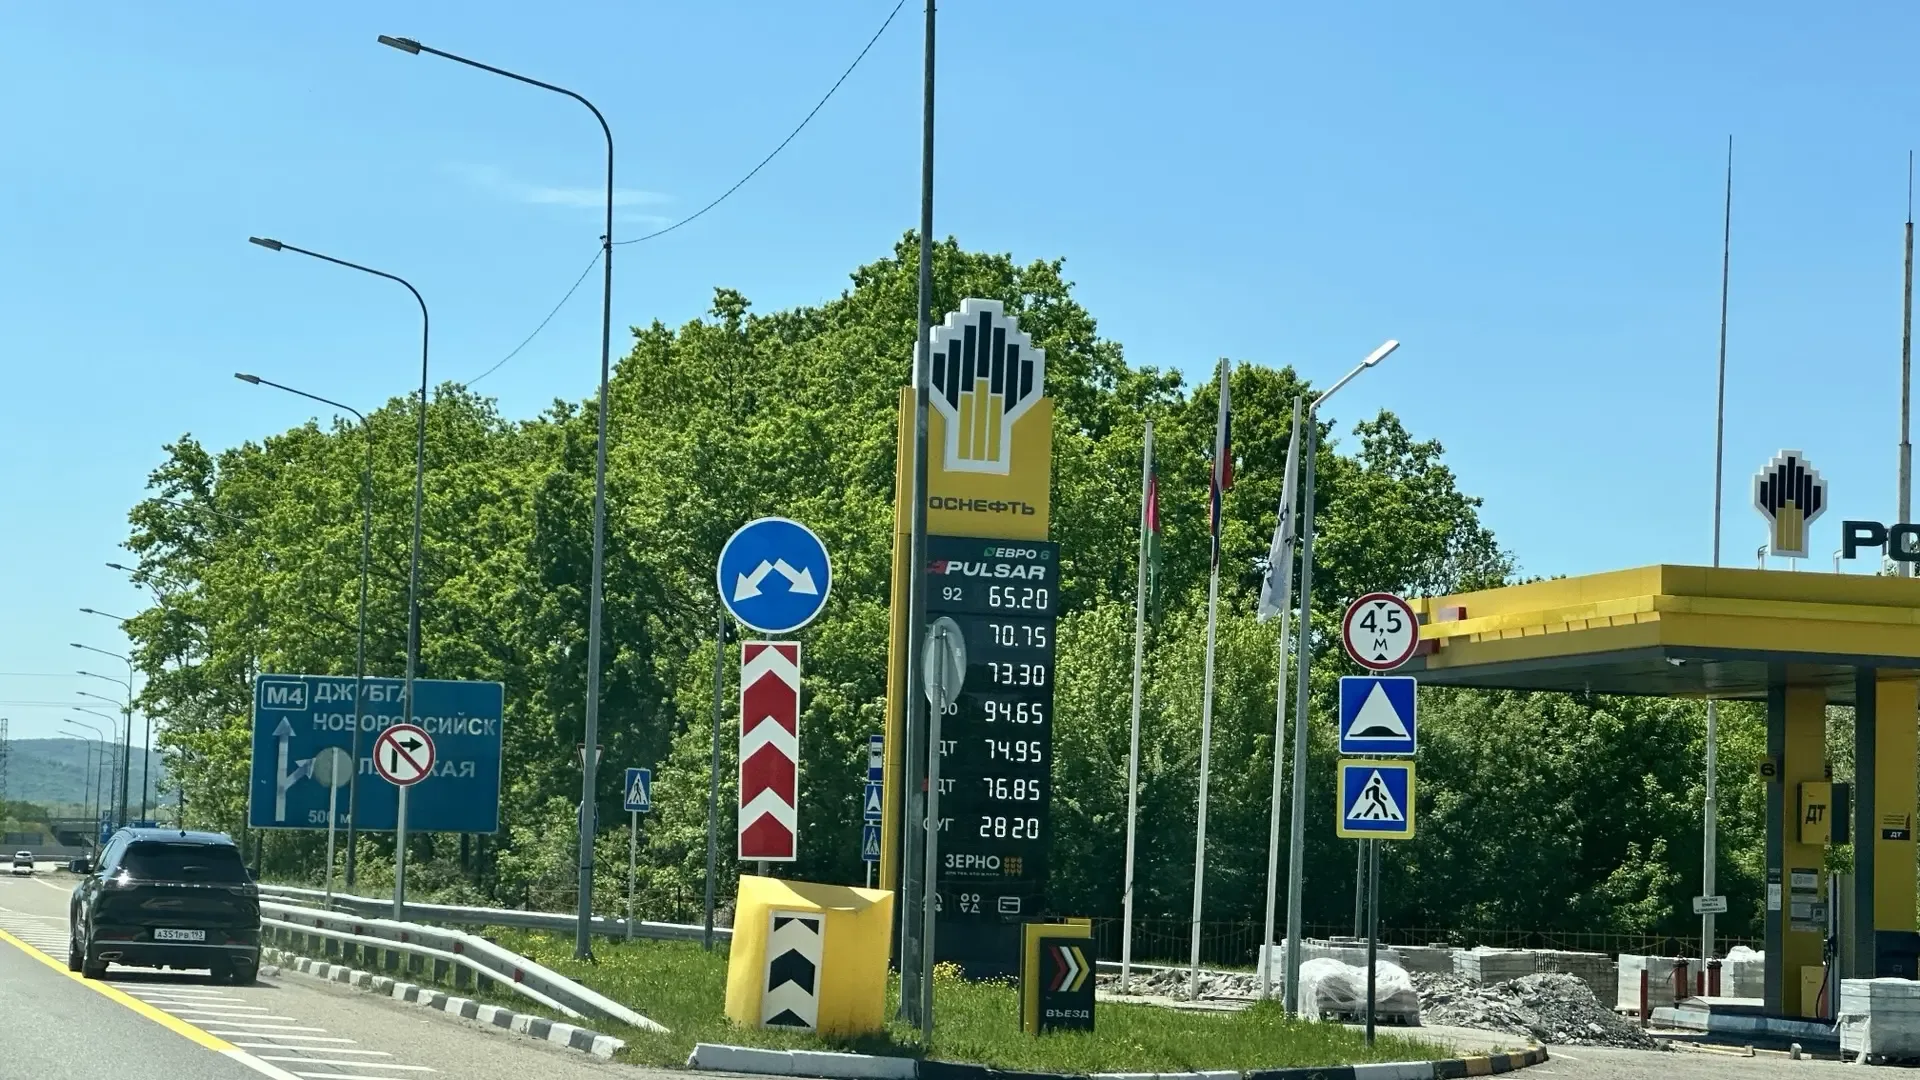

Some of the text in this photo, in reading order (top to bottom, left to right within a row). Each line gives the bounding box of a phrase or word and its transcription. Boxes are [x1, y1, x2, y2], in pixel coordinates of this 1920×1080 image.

[928, 496, 1035, 515] ОСНЕФТЬ
[1842, 520, 1920, 561] РО
[995, 547, 1051, 560] ЕВРО 6
[944, 560, 1046, 580] PULSAR
[942, 585, 1048, 610] 92 65.20
[1359, 609, 1402, 637] 4,5
[989, 624, 1046, 648] 70.75
[987, 662, 1045, 686] 73.30
[267, 687, 303, 705] М4
[313, 711, 497, 736] НОВОРСИЙСК
[984, 700, 1043, 724] 94.65
[984, 739, 1042, 763] 74.95
[983, 777, 1040, 801] 76.85
[1805, 804, 1826, 825] ДТ
[945, 853, 1001, 870] ЗЕРНО
[1046, 1009, 1089, 1018] ВЪЕЗД
